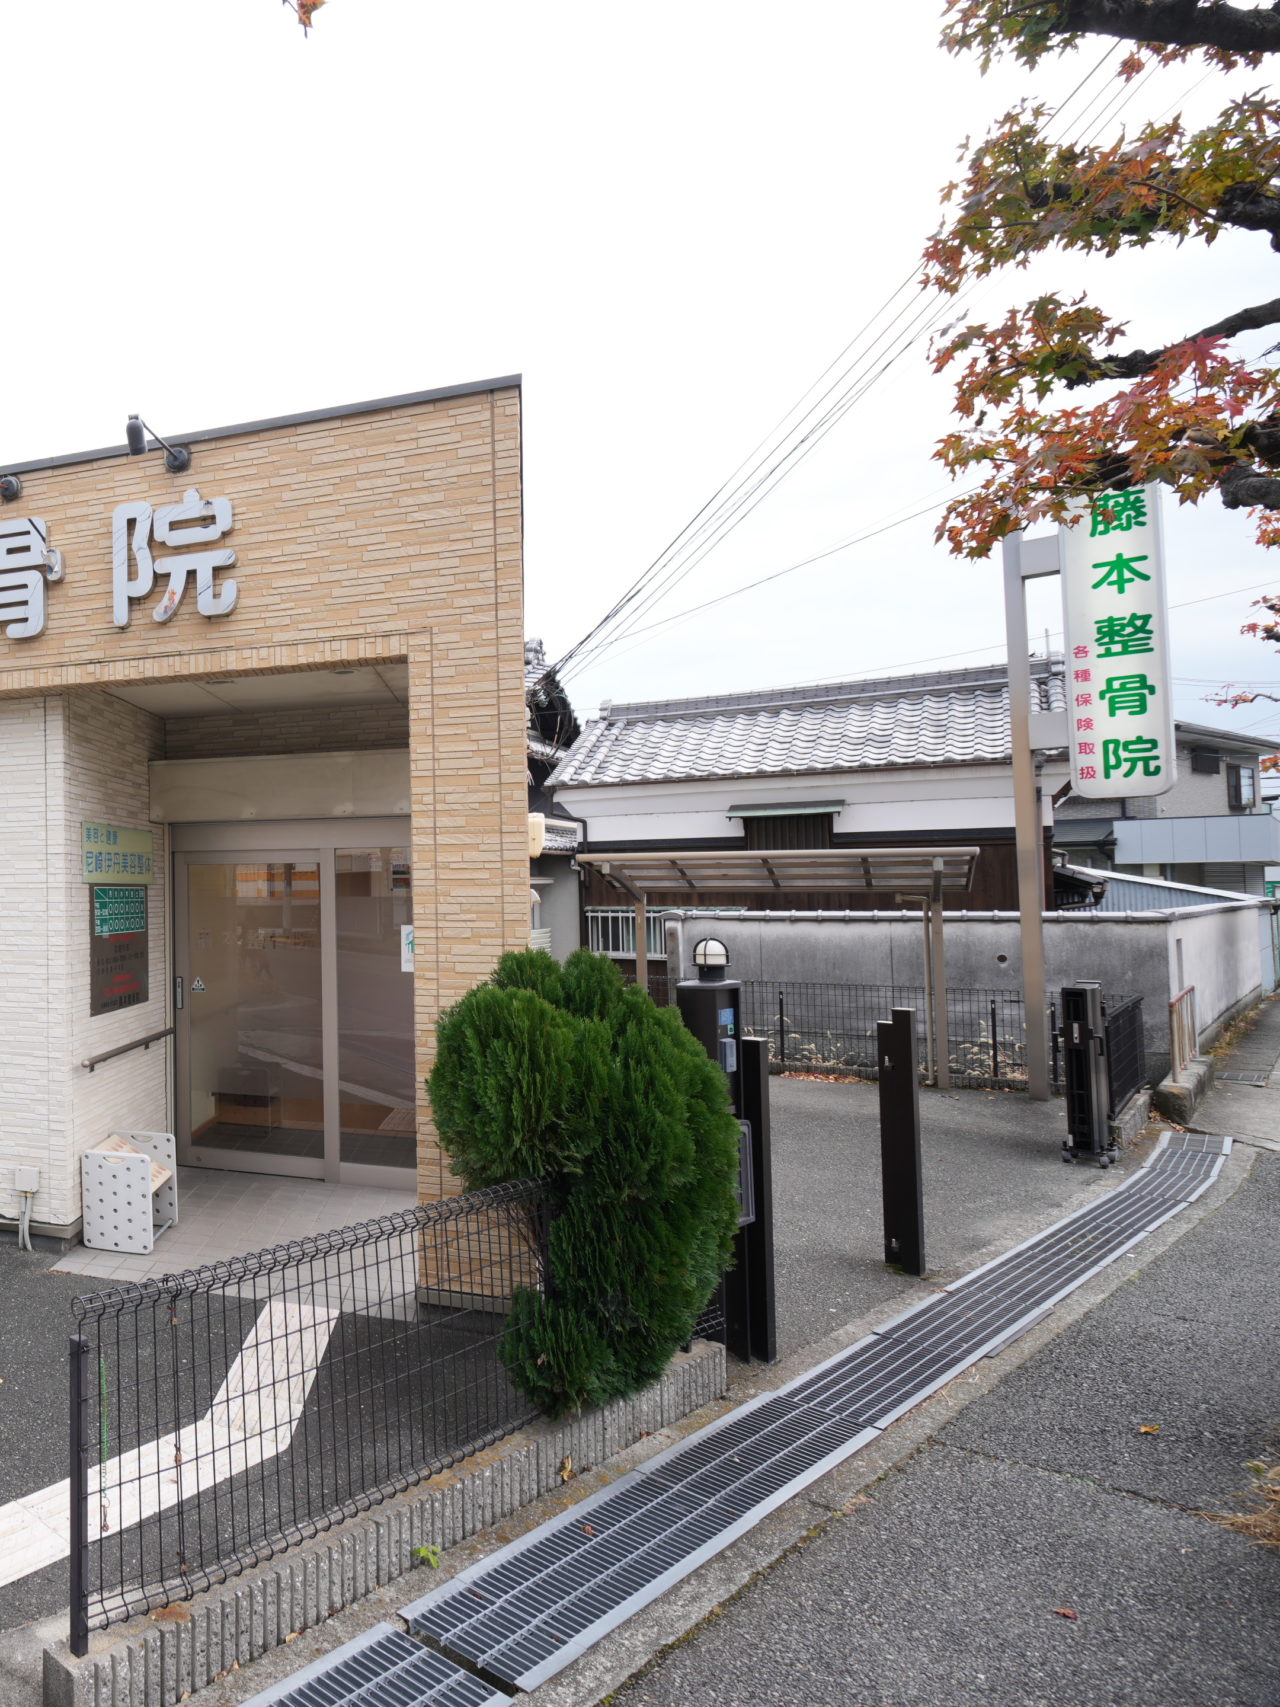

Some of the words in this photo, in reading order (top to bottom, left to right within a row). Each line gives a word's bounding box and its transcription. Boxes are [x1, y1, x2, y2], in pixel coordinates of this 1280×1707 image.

[1073, 645, 1097, 780] 各種保険取扱
[1089, 488, 1161, 780] 藤本整骨院
